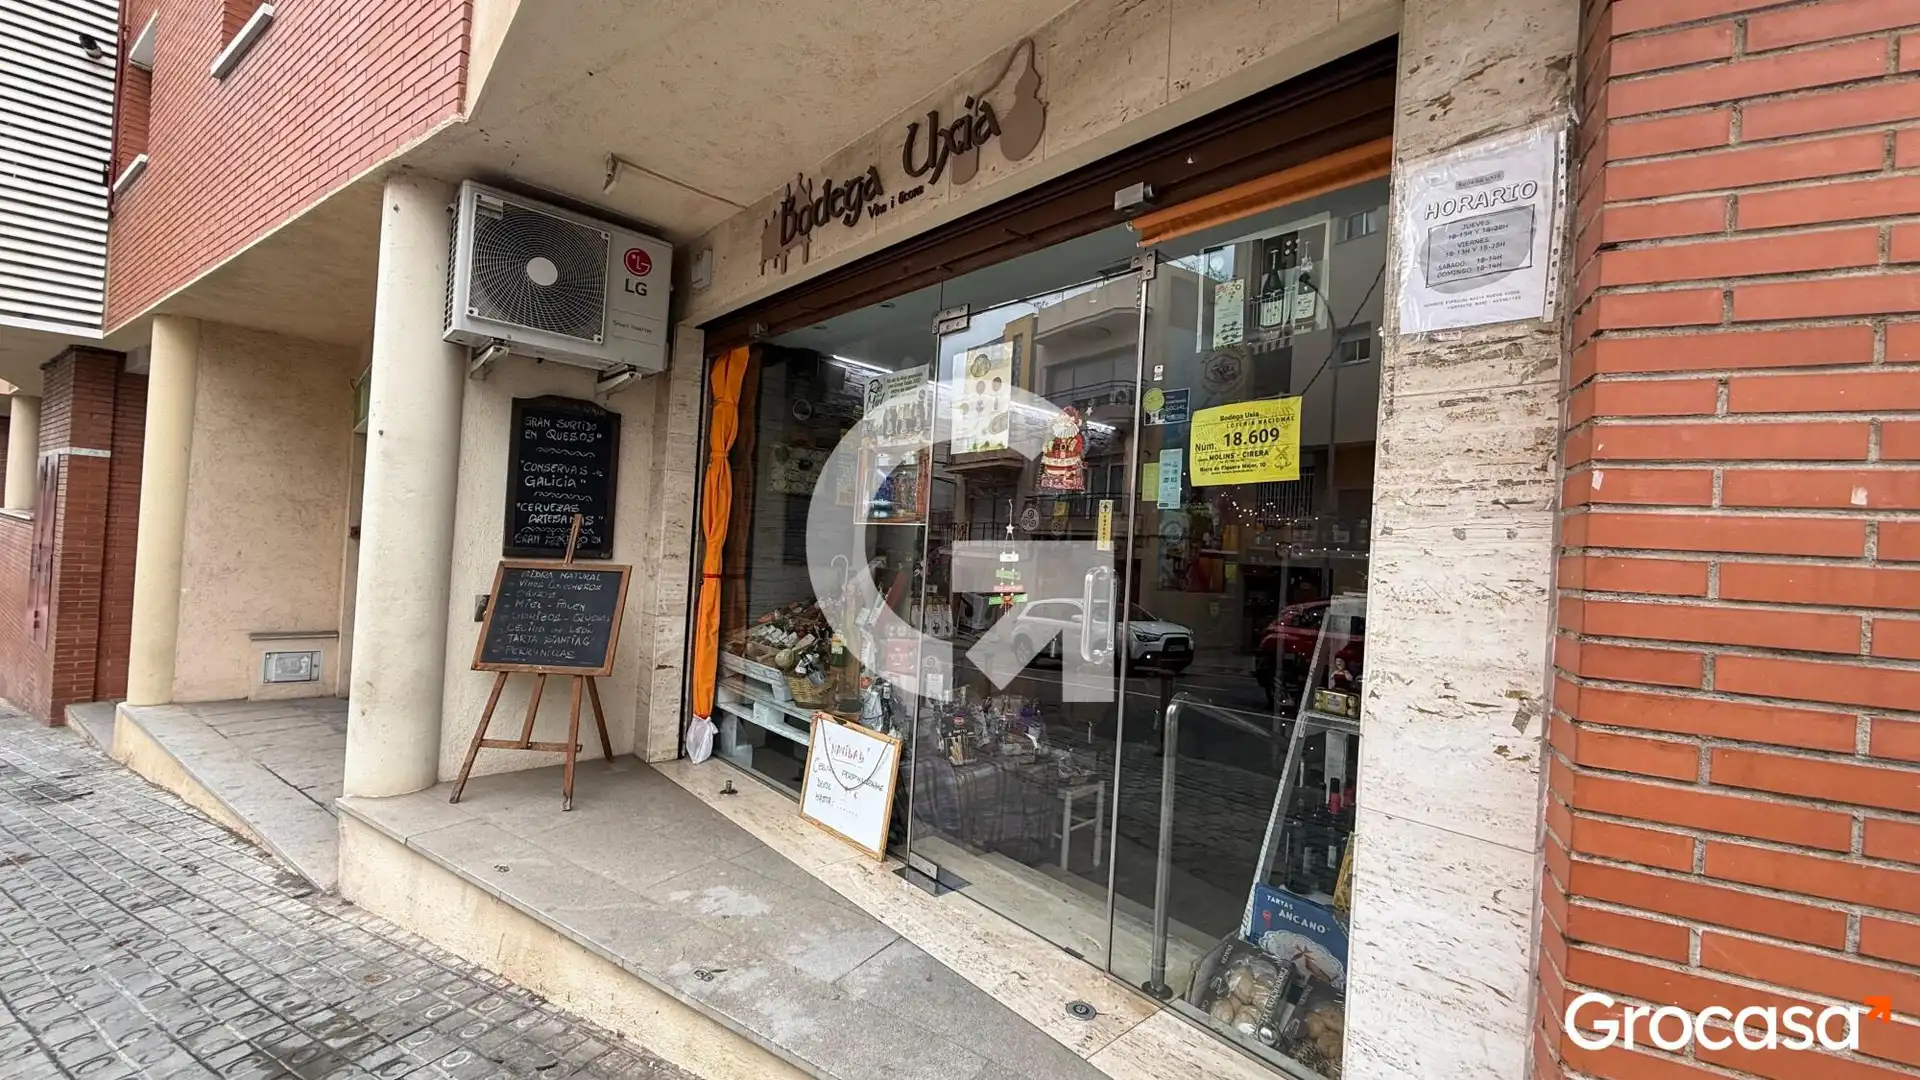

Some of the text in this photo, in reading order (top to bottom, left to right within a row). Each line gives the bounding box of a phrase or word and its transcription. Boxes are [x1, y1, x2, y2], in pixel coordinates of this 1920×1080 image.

[780, 165, 884, 247] Bodega
[1424, 180, 1538, 220] HORARIO
[624, 278, 648, 297] LG
[1220, 412, 1243, 422] Bodega
[1258, 415, 1295, 425] NACIONAL
[525, 429, 538, 440] EN
[1223, 427, 1280, 447] 18.609
[1195, 442, 1217, 452] Núm.
[1209, 452, 1236, 461] MOLINS
[1242, 449, 1269, 458] CIRERA
[560, 571, 603, 582] NATURAL
[515, 598, 542, 609] MIEL
[507, 633, 538, 645] TARTA
[1266, 894, 1294, 911] TARTAS
[1278, 909, 1327, 934] ANCANO
